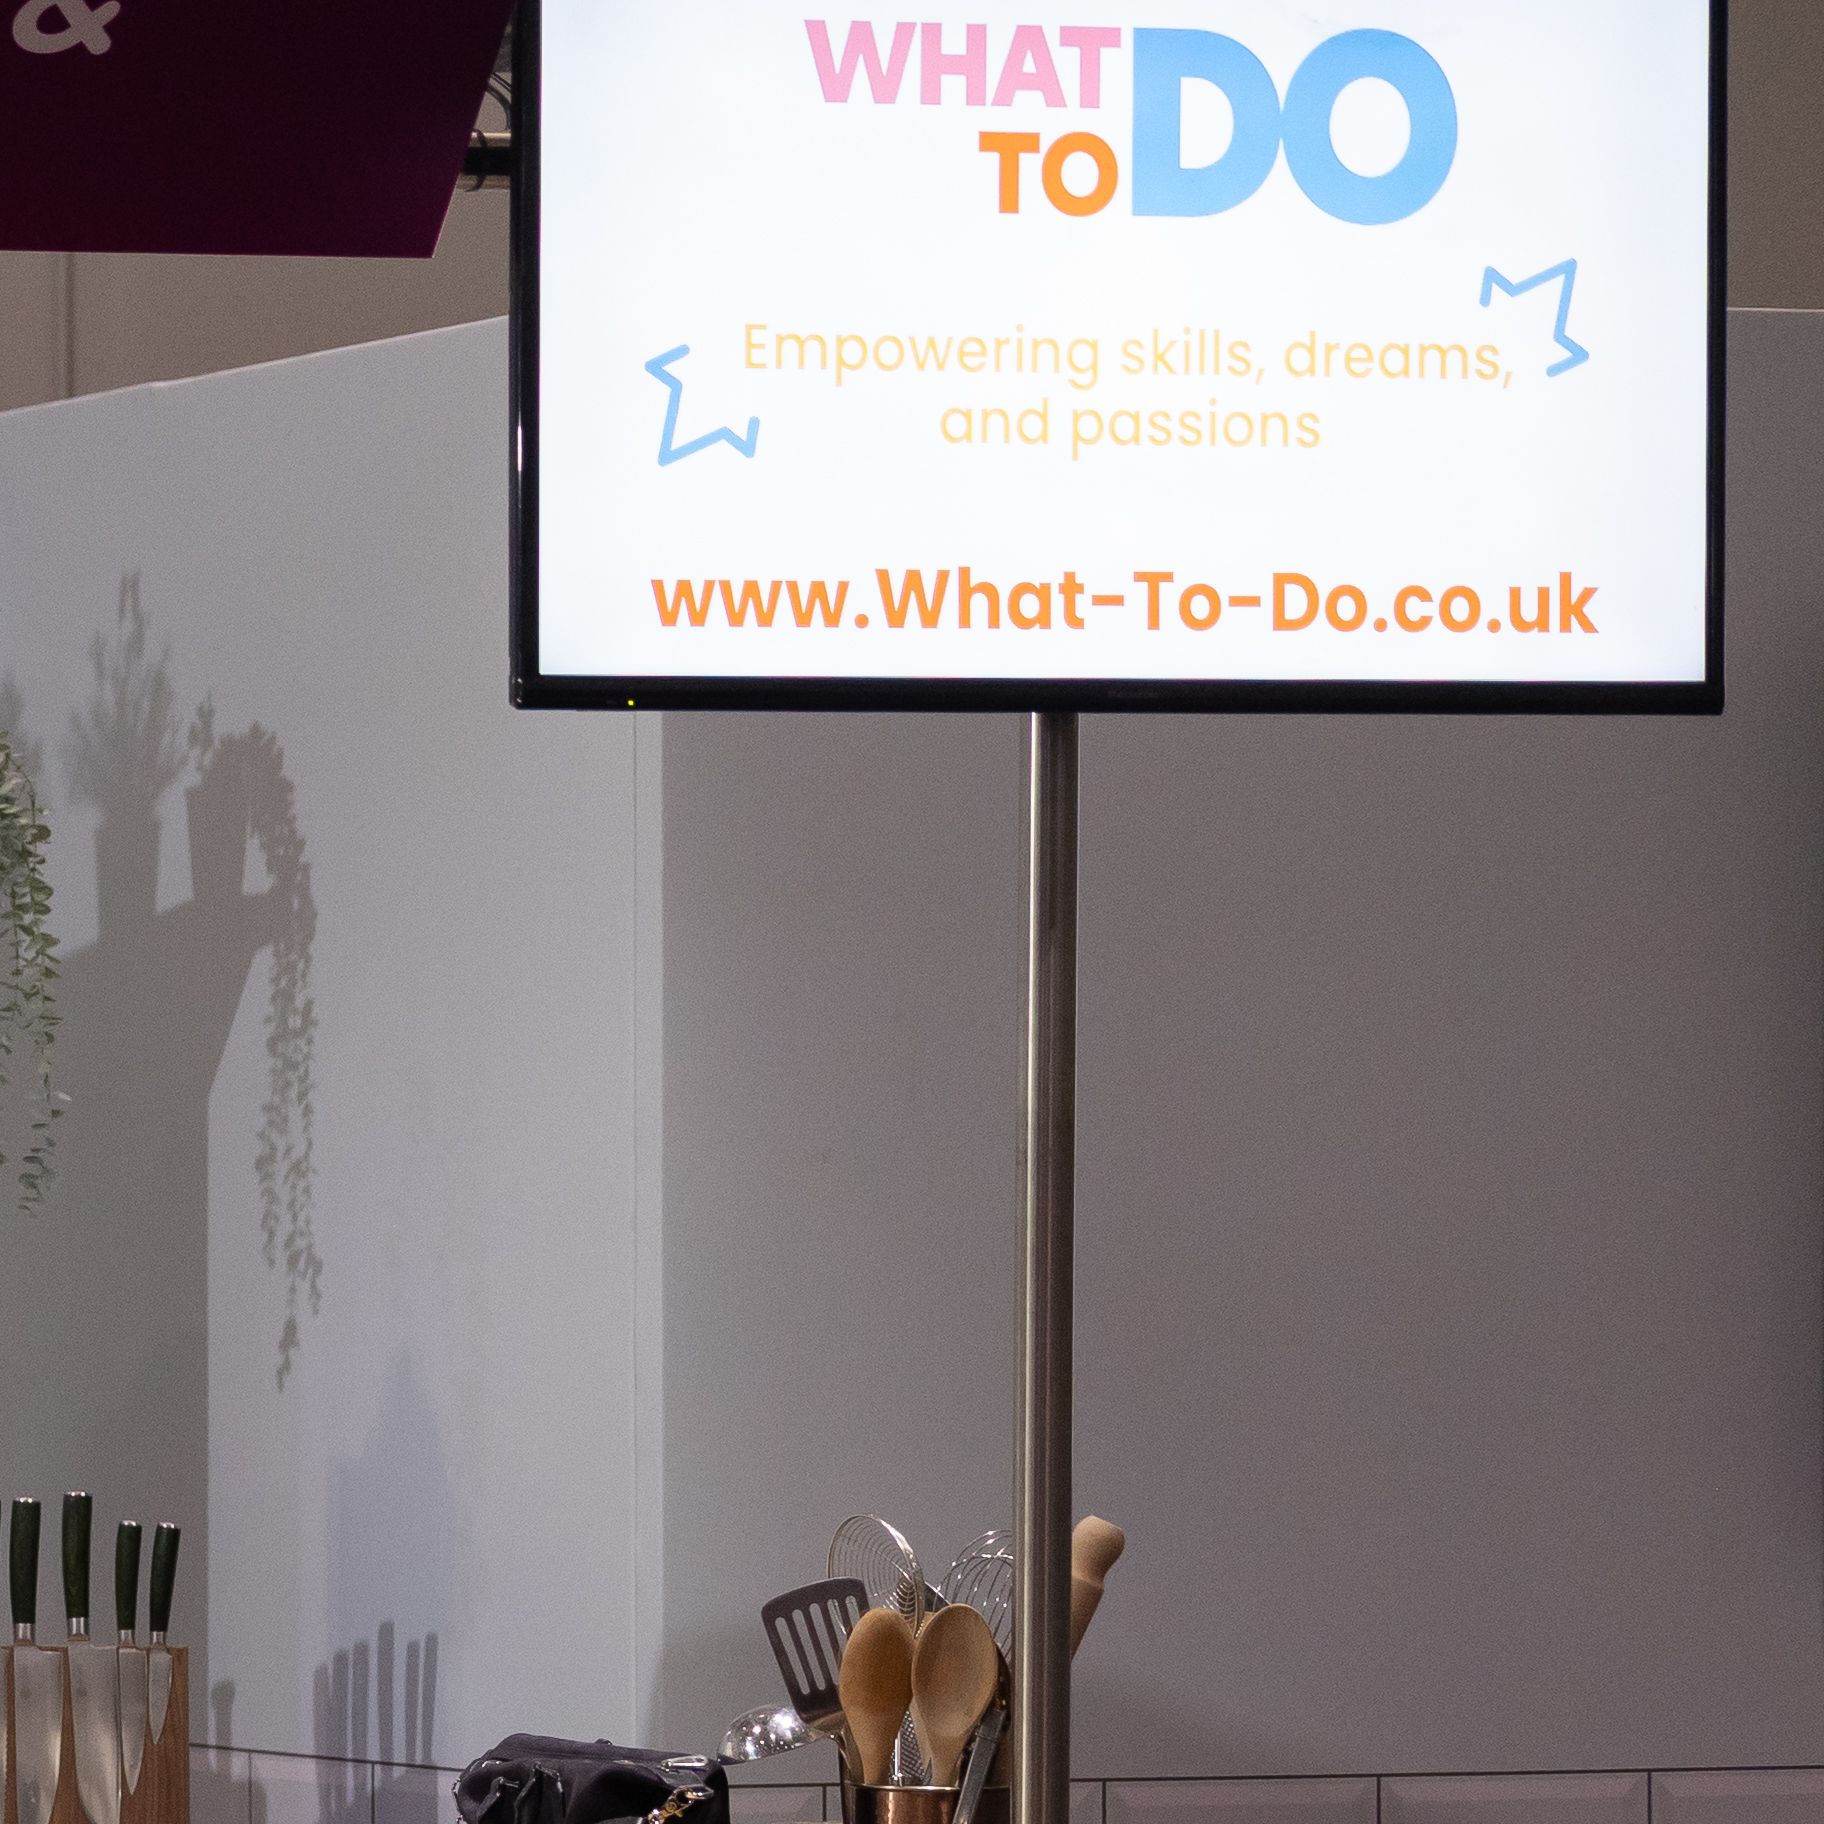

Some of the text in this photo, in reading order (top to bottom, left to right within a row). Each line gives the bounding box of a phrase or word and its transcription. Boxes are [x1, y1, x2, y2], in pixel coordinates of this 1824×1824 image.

[805, 20, 1121, 109] WHAT
[1132, 27, 1459, 226] DO
[978, 131, 1120, 217] TO
[743, 323, 1513, 391] Empowering skills, dreams,
[939, 399, 1322, 462] and passions
[650, 565, 1600, 635] www.What-To-Do.co.uk
